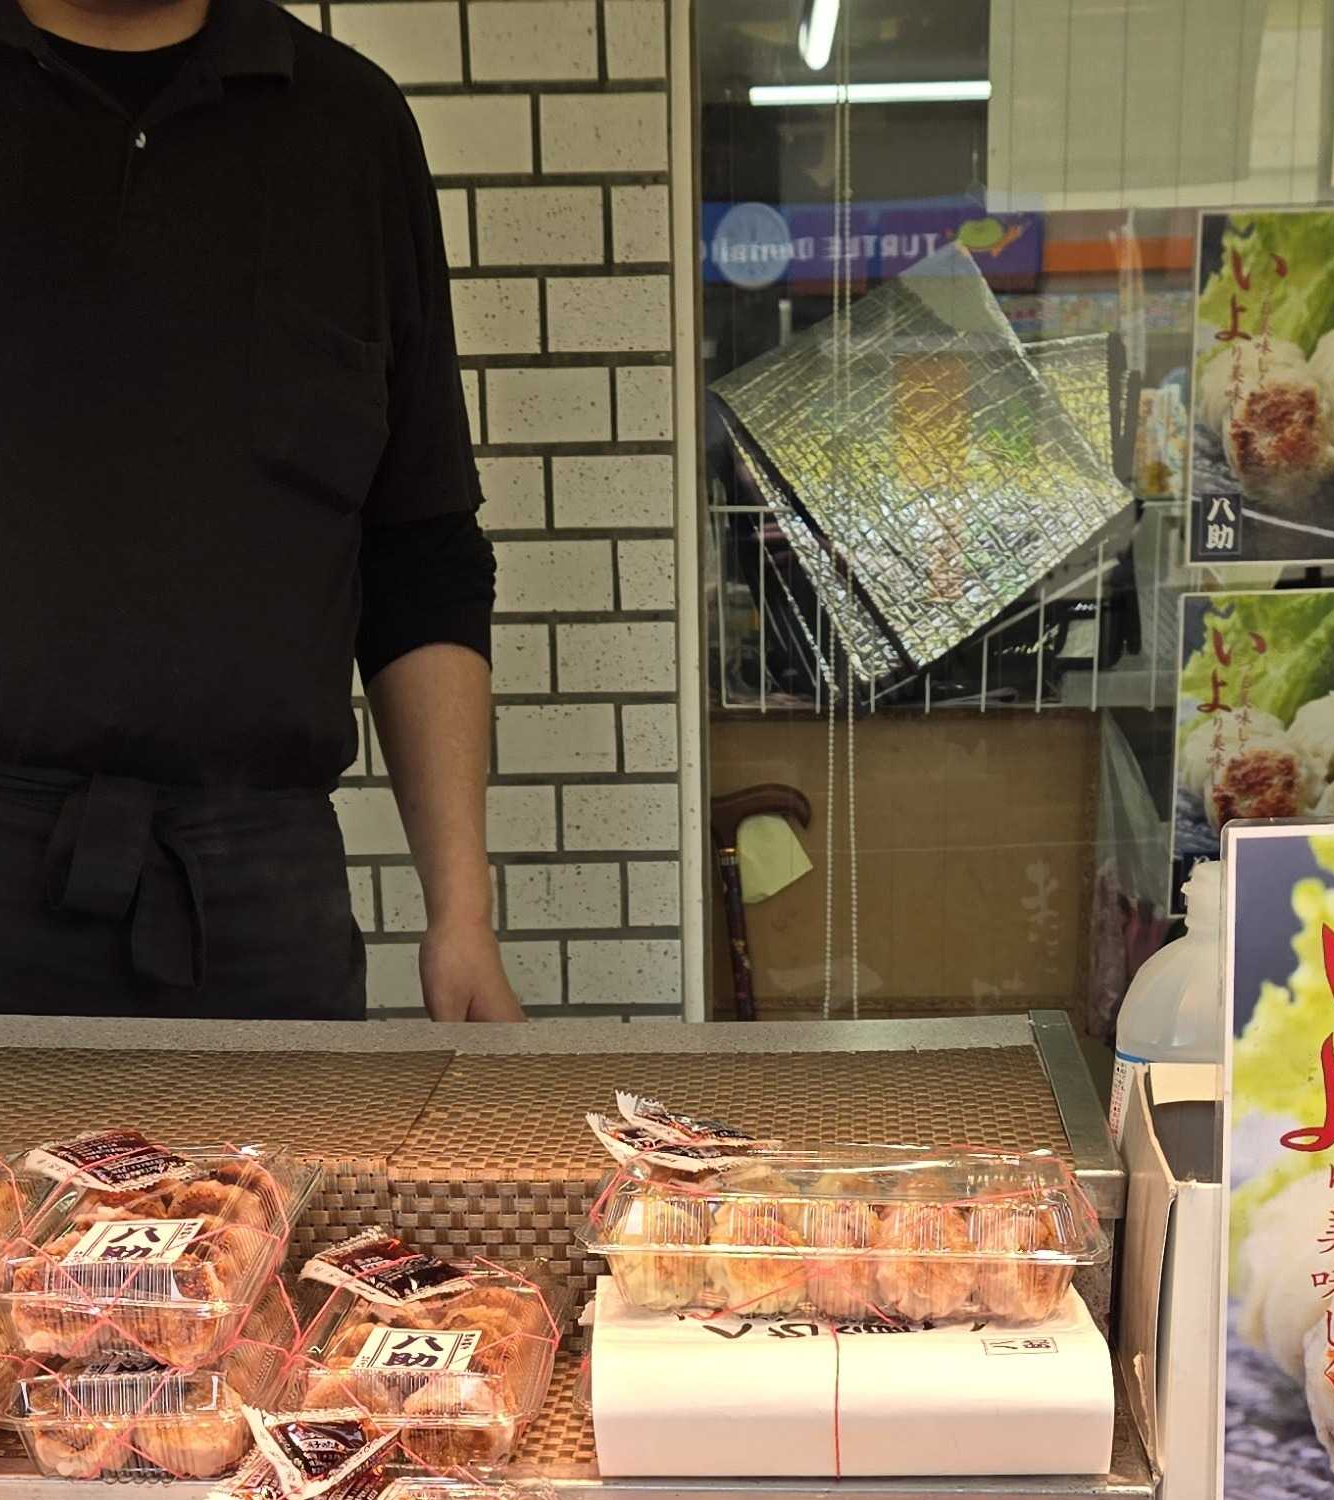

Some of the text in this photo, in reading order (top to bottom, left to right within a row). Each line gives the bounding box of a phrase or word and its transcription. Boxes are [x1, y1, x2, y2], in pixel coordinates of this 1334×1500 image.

[1206, 496, 1235, 550] 八助
[99, 1226, 161, 1258] 八助
[382, 1335, 444, 1367] 八助
